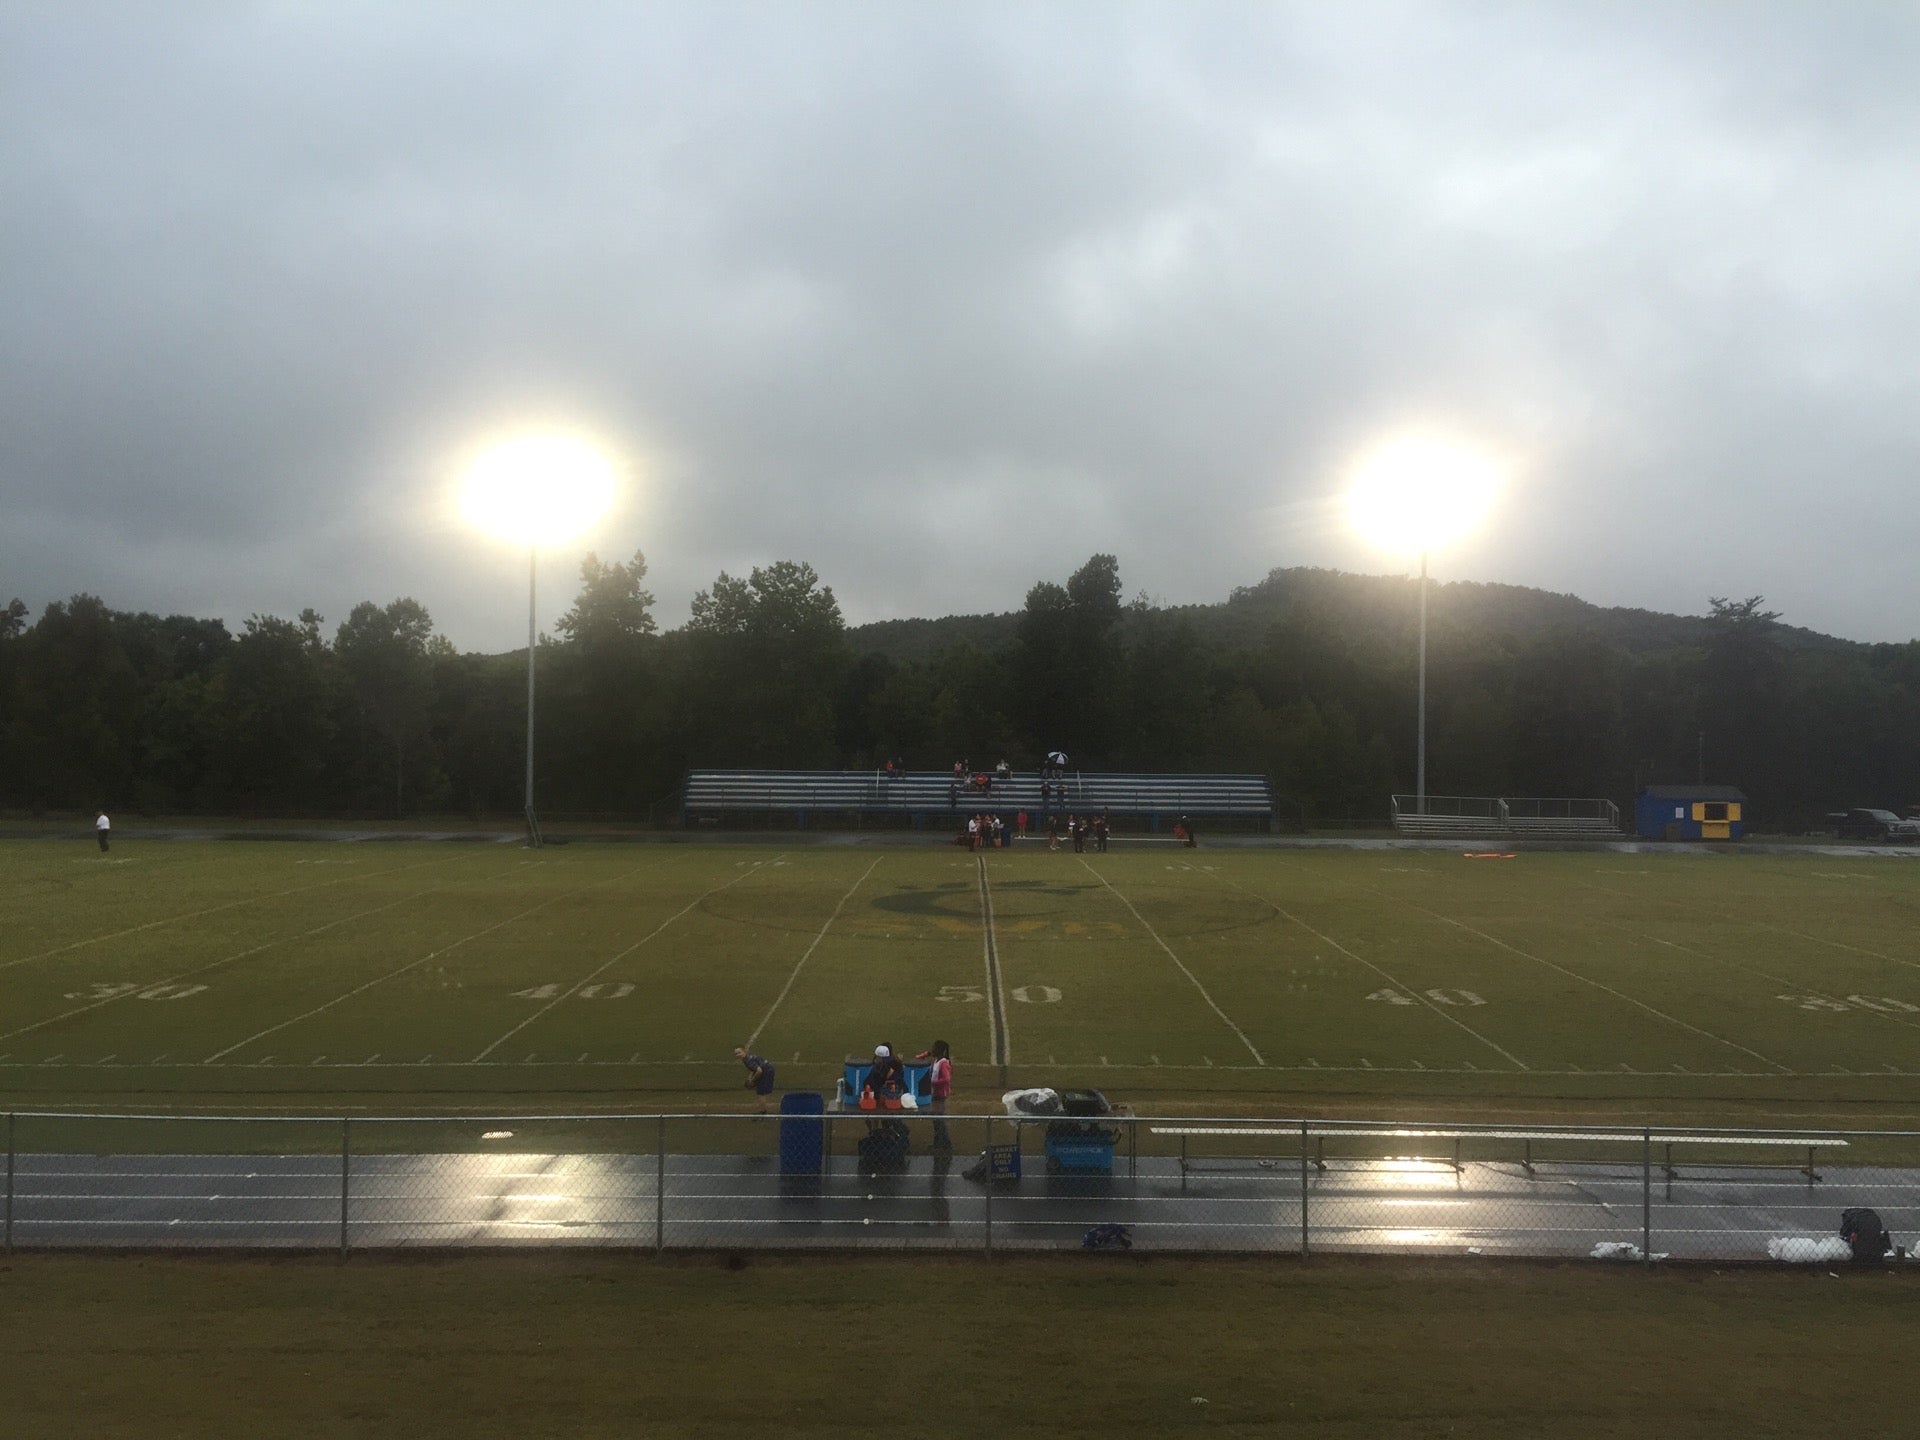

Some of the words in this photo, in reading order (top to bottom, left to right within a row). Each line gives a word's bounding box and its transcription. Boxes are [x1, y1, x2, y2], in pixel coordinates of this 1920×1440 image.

[509, 982, 635, 999] 40
[934, 985, 1063, 1003] 50
[1364, 988, 1489, 1006] 40
